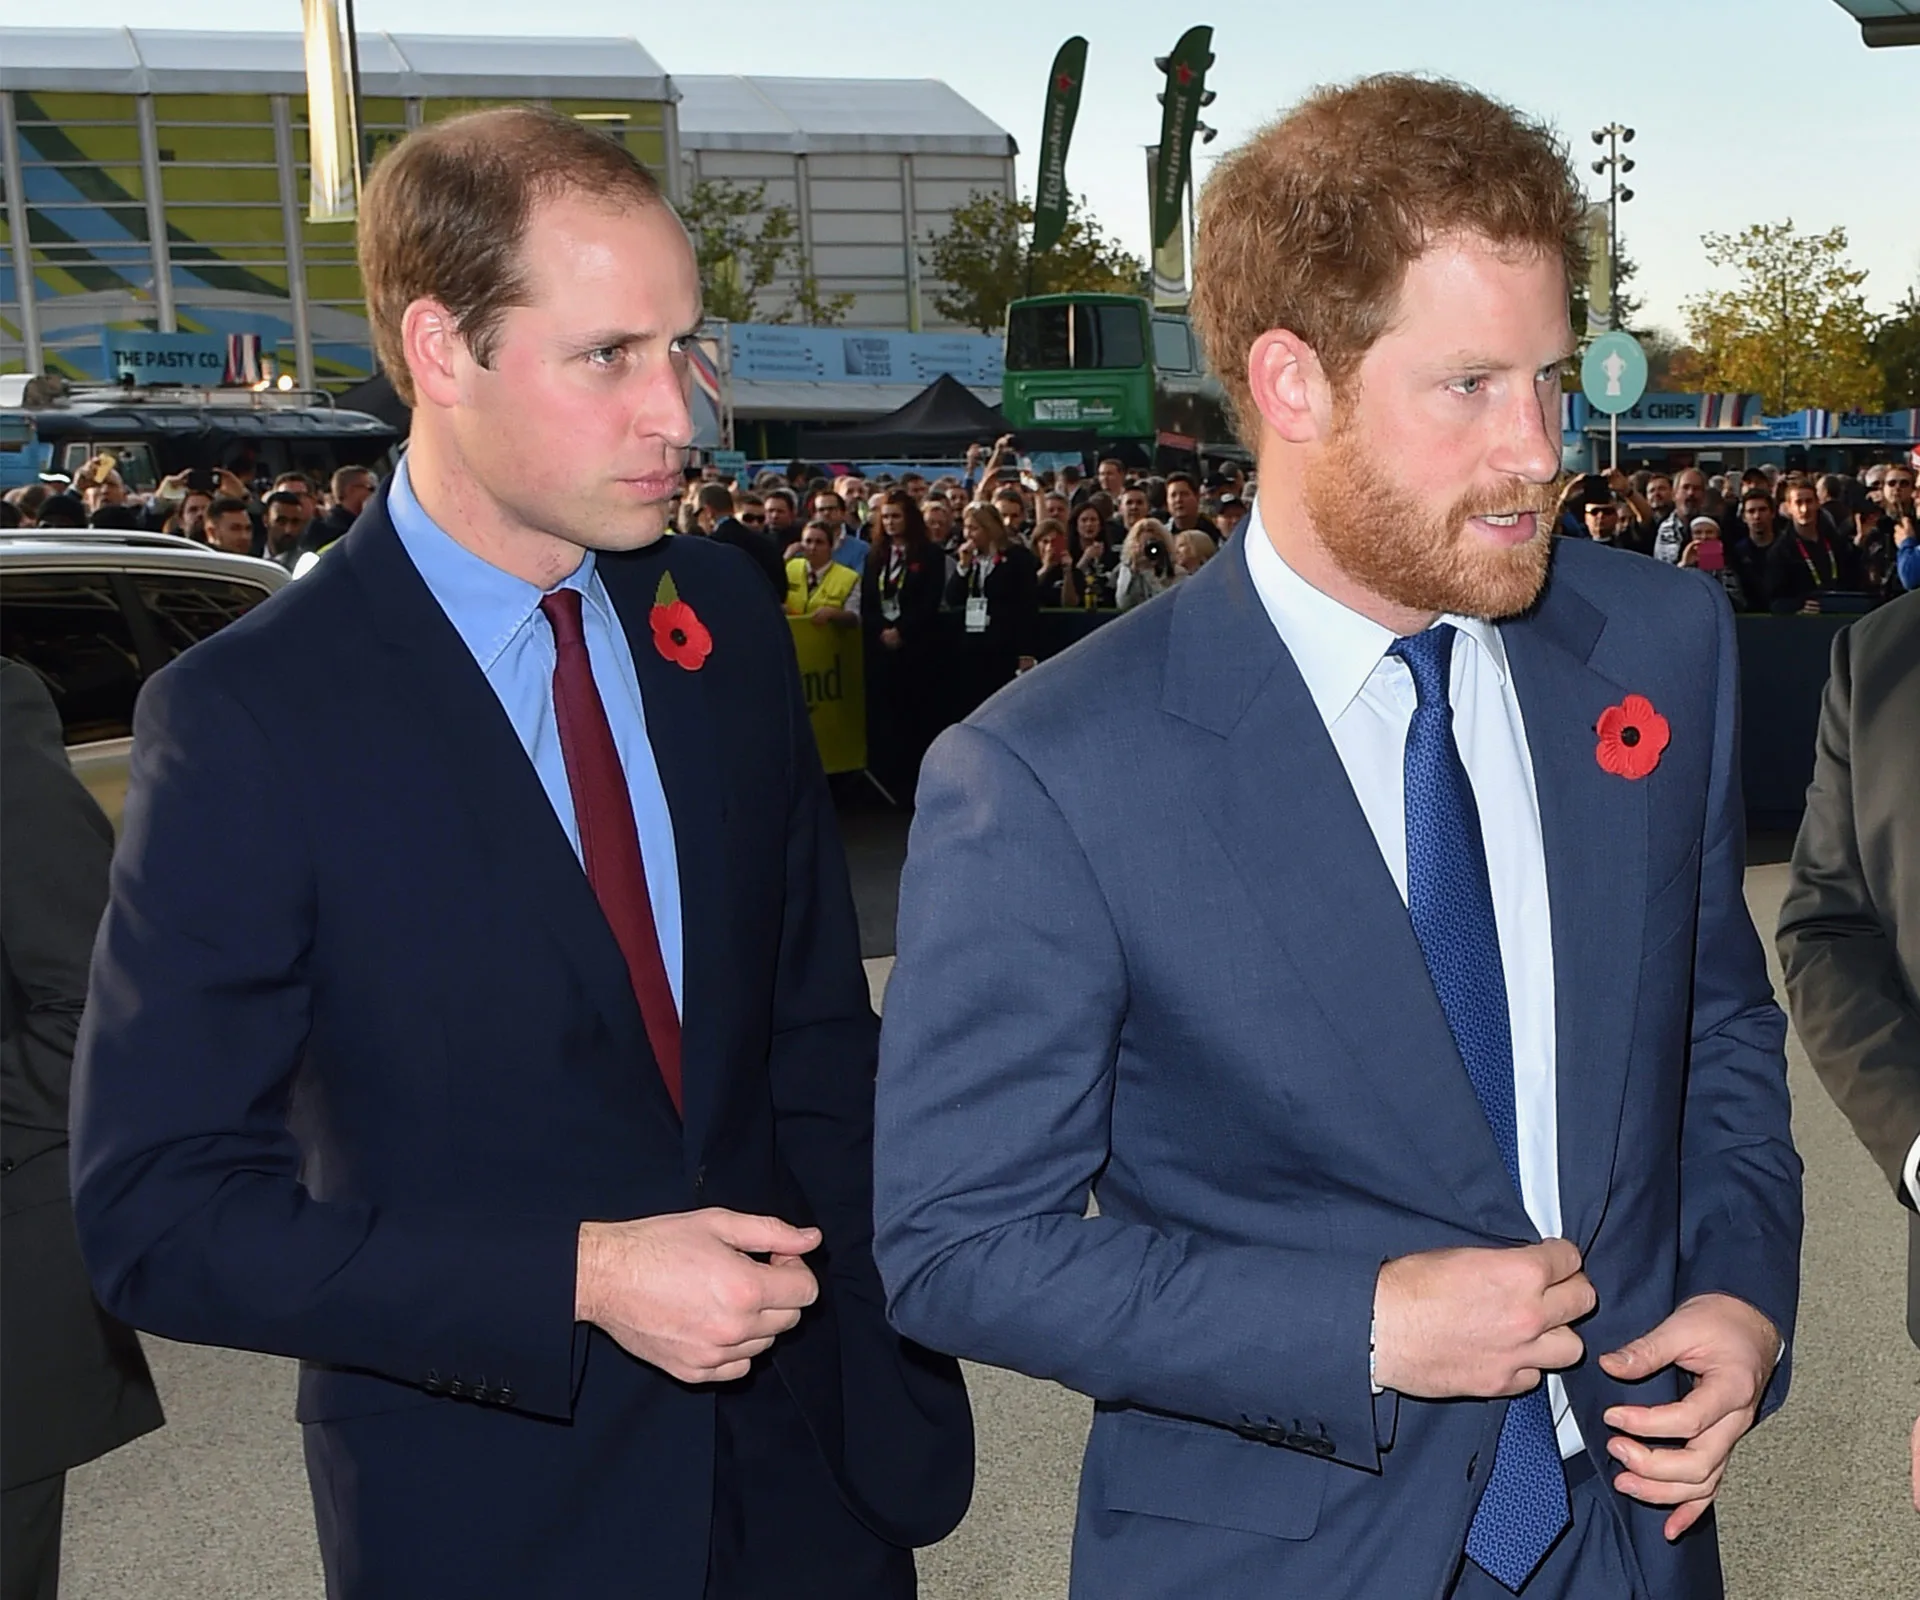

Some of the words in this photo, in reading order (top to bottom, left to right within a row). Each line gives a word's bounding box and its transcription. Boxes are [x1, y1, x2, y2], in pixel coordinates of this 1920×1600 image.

[1041, 103, 1067, 212] Heineken
[112, 350, 143, 367] THE
[146, 351, 195, 368] PASTY
[199, 352, 224, 368] CO.
[864, 363, 892, 377] 2015
[1648, 403, 1696, 419] CHIPS
[1842, 414, 1894, 427] COFFEE
